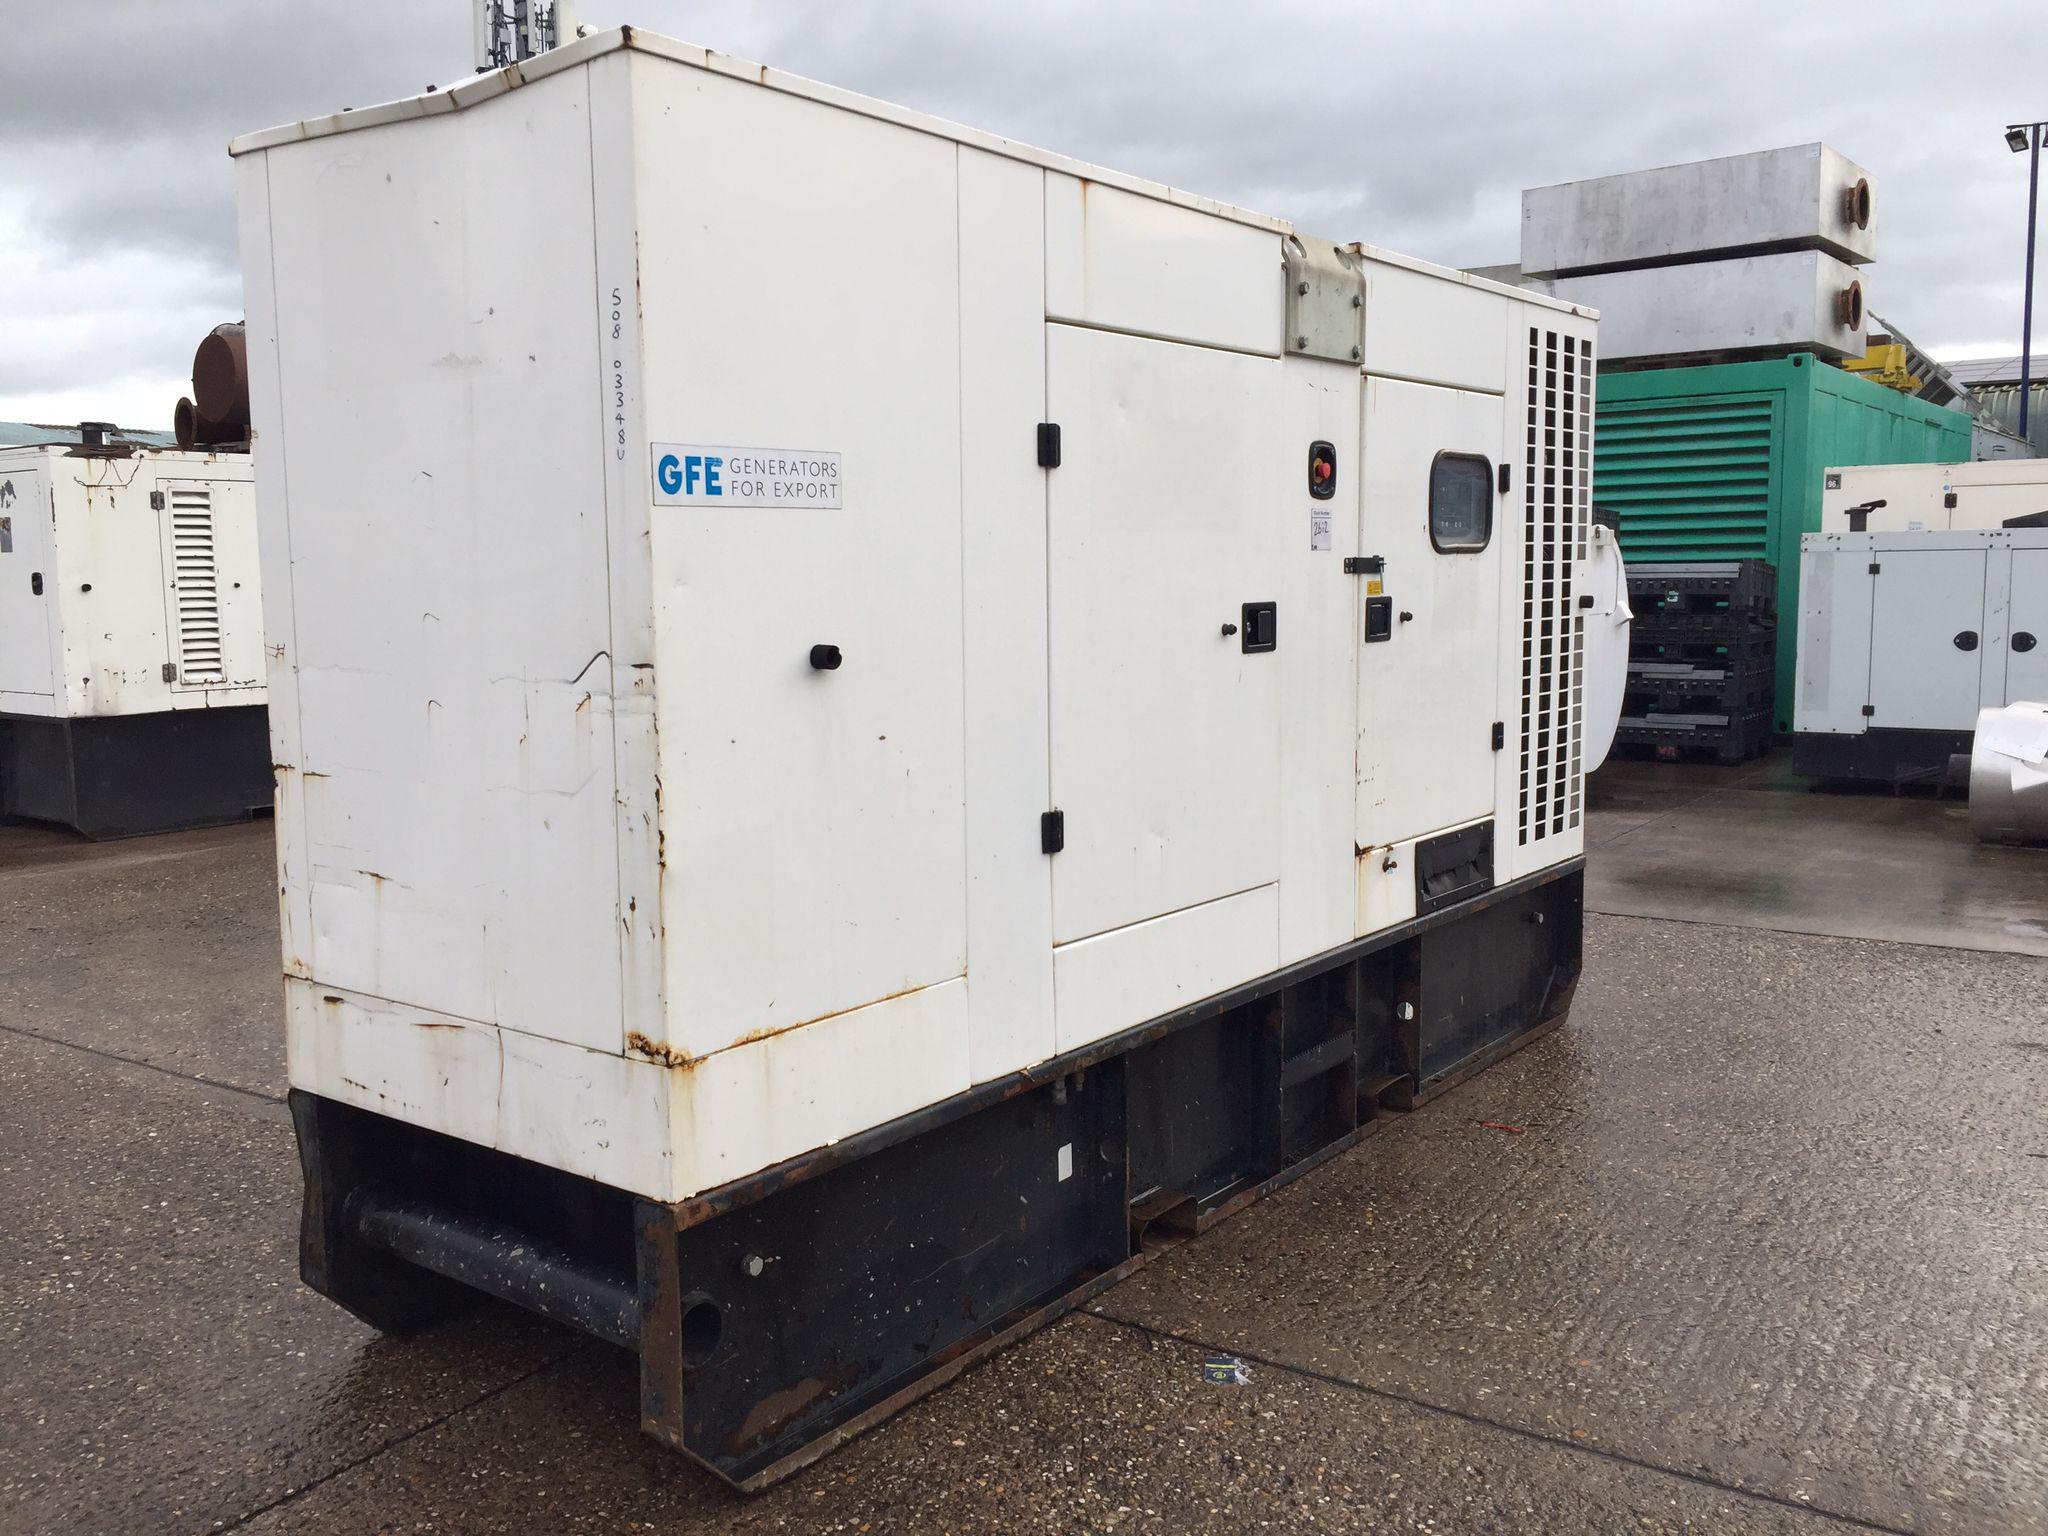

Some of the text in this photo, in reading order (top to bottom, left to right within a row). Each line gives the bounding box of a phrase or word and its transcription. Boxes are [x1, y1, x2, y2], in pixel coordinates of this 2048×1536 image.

[658, 454, 724, 496] GFE
[729, 457, 838, 478] GENERATORS
[731, 480, 838, 499] FOR EXPORT
